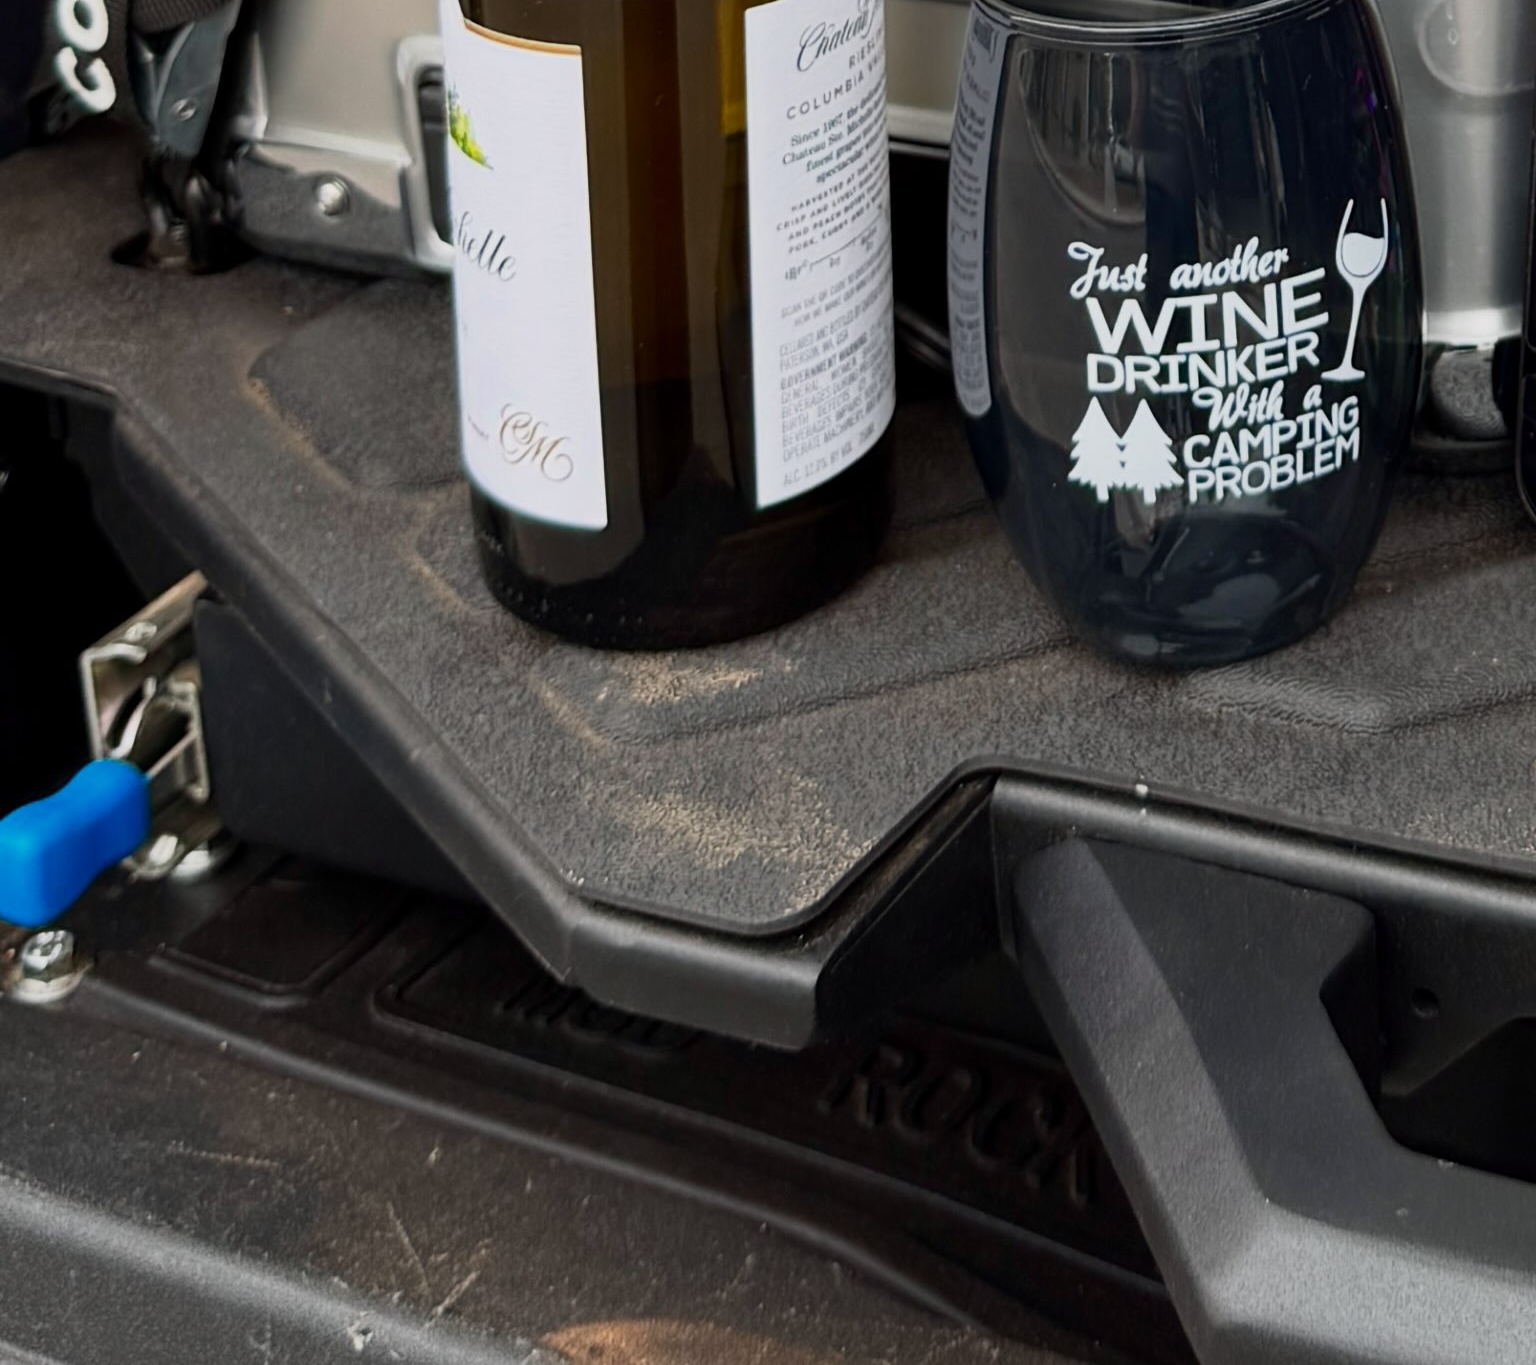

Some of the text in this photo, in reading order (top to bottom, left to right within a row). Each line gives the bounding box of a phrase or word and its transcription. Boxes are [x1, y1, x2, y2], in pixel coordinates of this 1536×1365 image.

[786, 68, 865, 121] COLUMBIA
[781, 141, 826, 167] Chateau
[775, 213, 807, 233] CRISP
[787, 225, 811, 242] AND
[1066, 235, 1290, 300] Just another
[1085, 266, 1329, 356] WINE
[780, 352, 838, 391] GOVERNMENT
[1085, 330, 1321, 395] DRINKER
[1181, 394, 1361, 470] CAMPING
[1191, 377, 1323, 434] With a
[1187, 425, 1361, 503] PROBLEM
